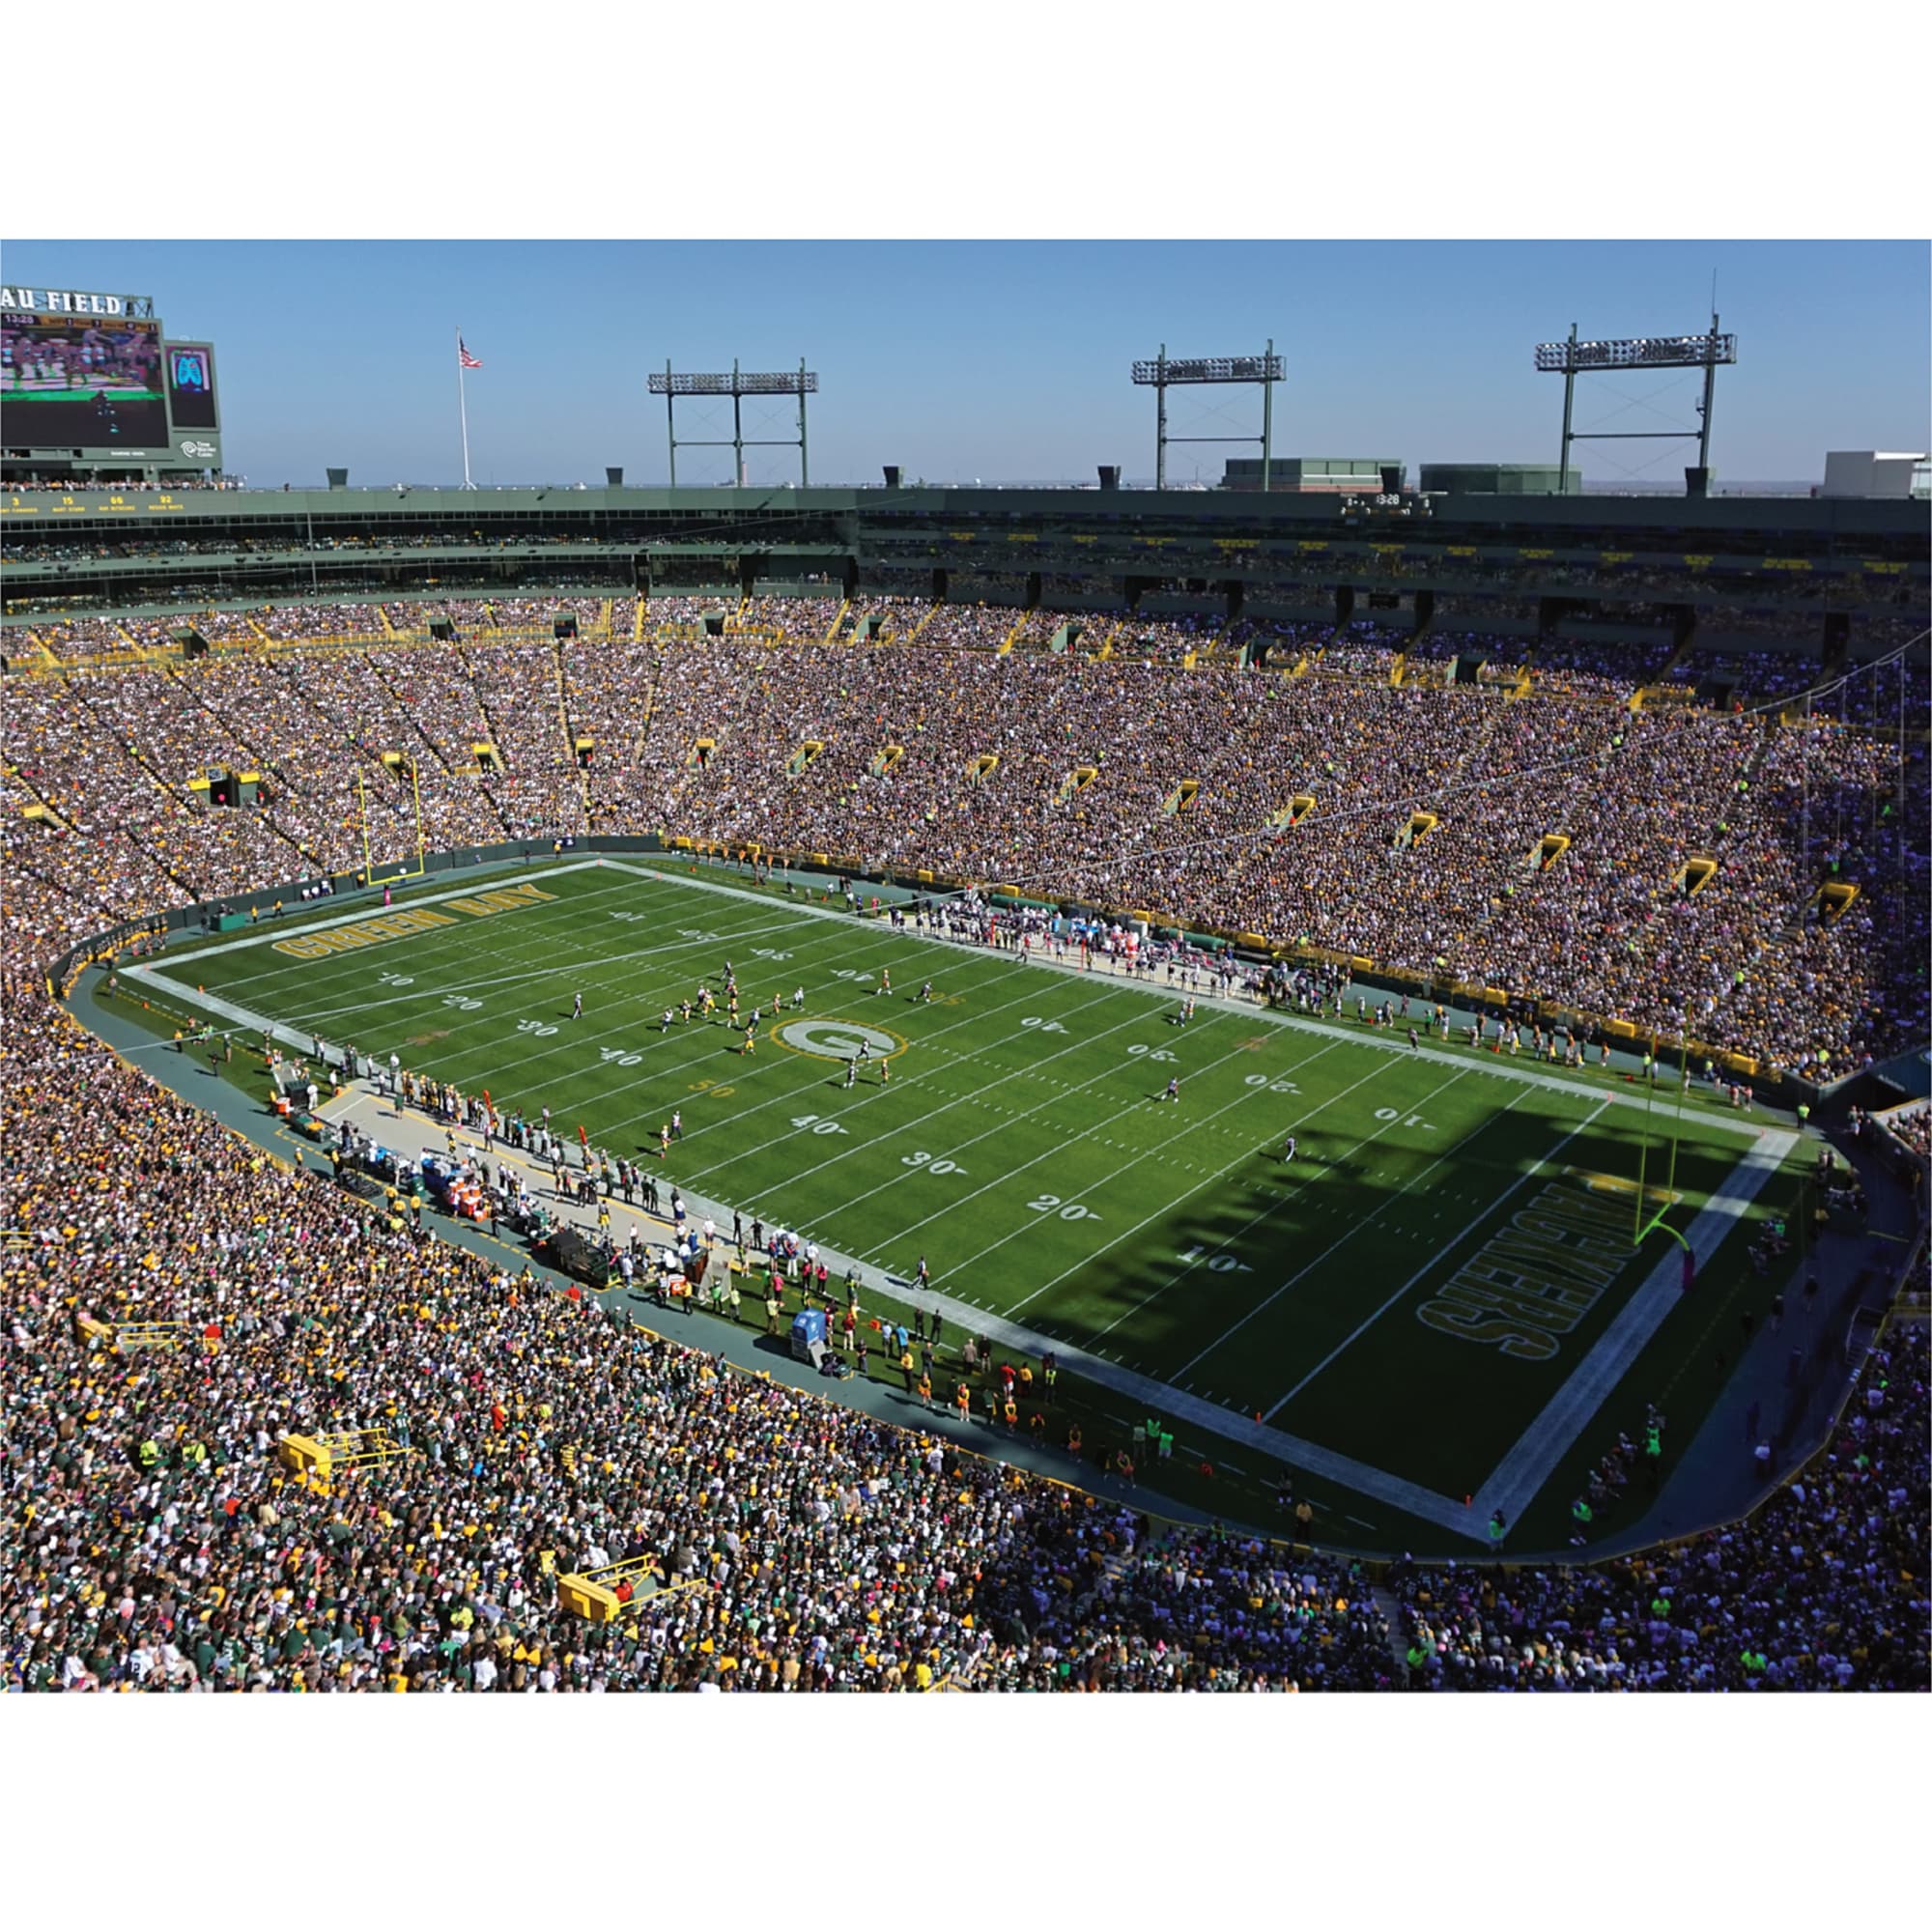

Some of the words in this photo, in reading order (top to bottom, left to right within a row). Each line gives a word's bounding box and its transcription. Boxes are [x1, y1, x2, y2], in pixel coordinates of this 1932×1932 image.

[46, 291, 121, 315] FIELD
[12, 497, 20, 506] 3
[62, 497, 74, 505] 15
[110, 497, 124, 505] 66
[270, 908, 461, 959] GREEN
[440, 883, 559, 917] BAY
[442, 995, 483, 1010] 20
[518, 1019, 558, 1037] 30
[601, 1048, 642, 1066] 40
[688, 1080, 735, 1097] 50
[1245, 1074, 1296, 1093] 20
[790, 1115, 839, 1135] 40
[1374, 1107, 1424, 1127] 10
[901, 1151, 956, 1175] 30
[1027, 1194, 1088, 1220] 20
[1176, 1245, 1237, 1272] 10
[1416, 1166, 1684, 1361] PACKERS
